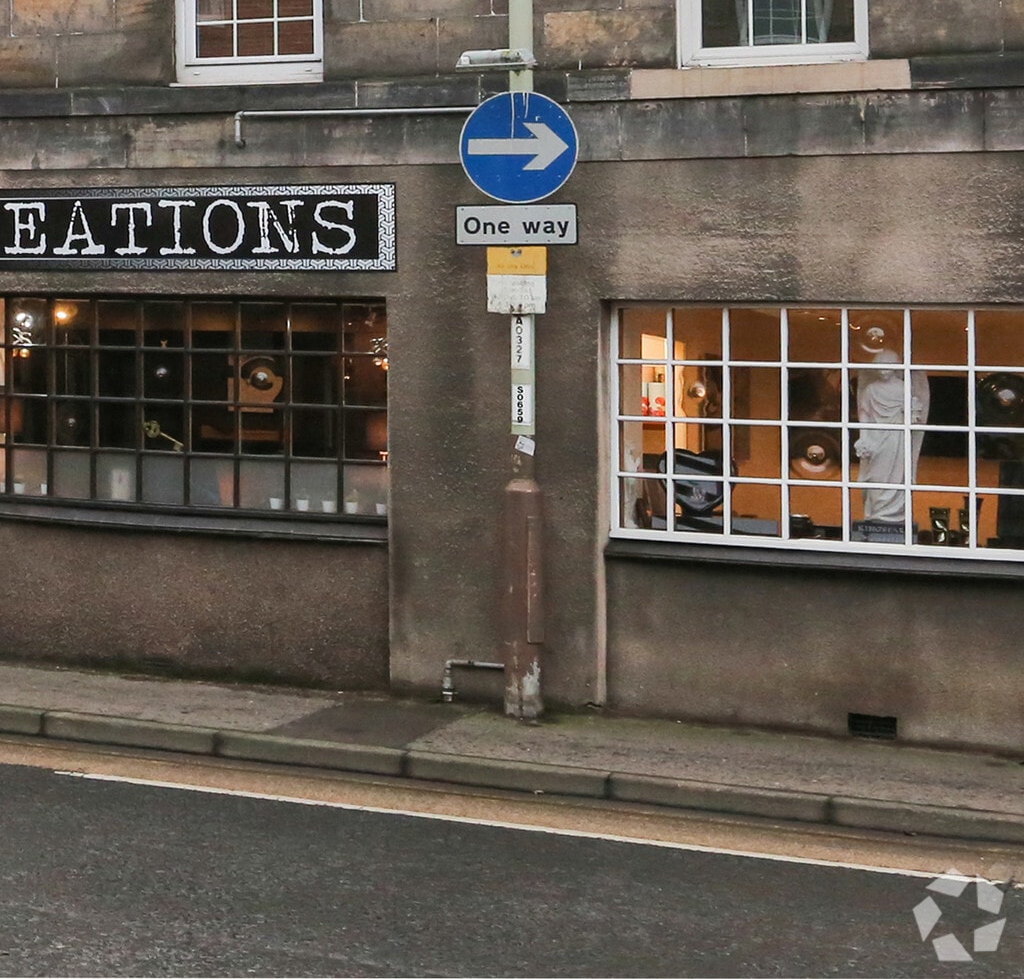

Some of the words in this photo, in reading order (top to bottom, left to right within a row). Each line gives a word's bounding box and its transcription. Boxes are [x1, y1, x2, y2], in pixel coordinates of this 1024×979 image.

[464, 216, 510, 234] One
[522, 220, 569, 238] way
[516, 386, 524, 423] S0659
